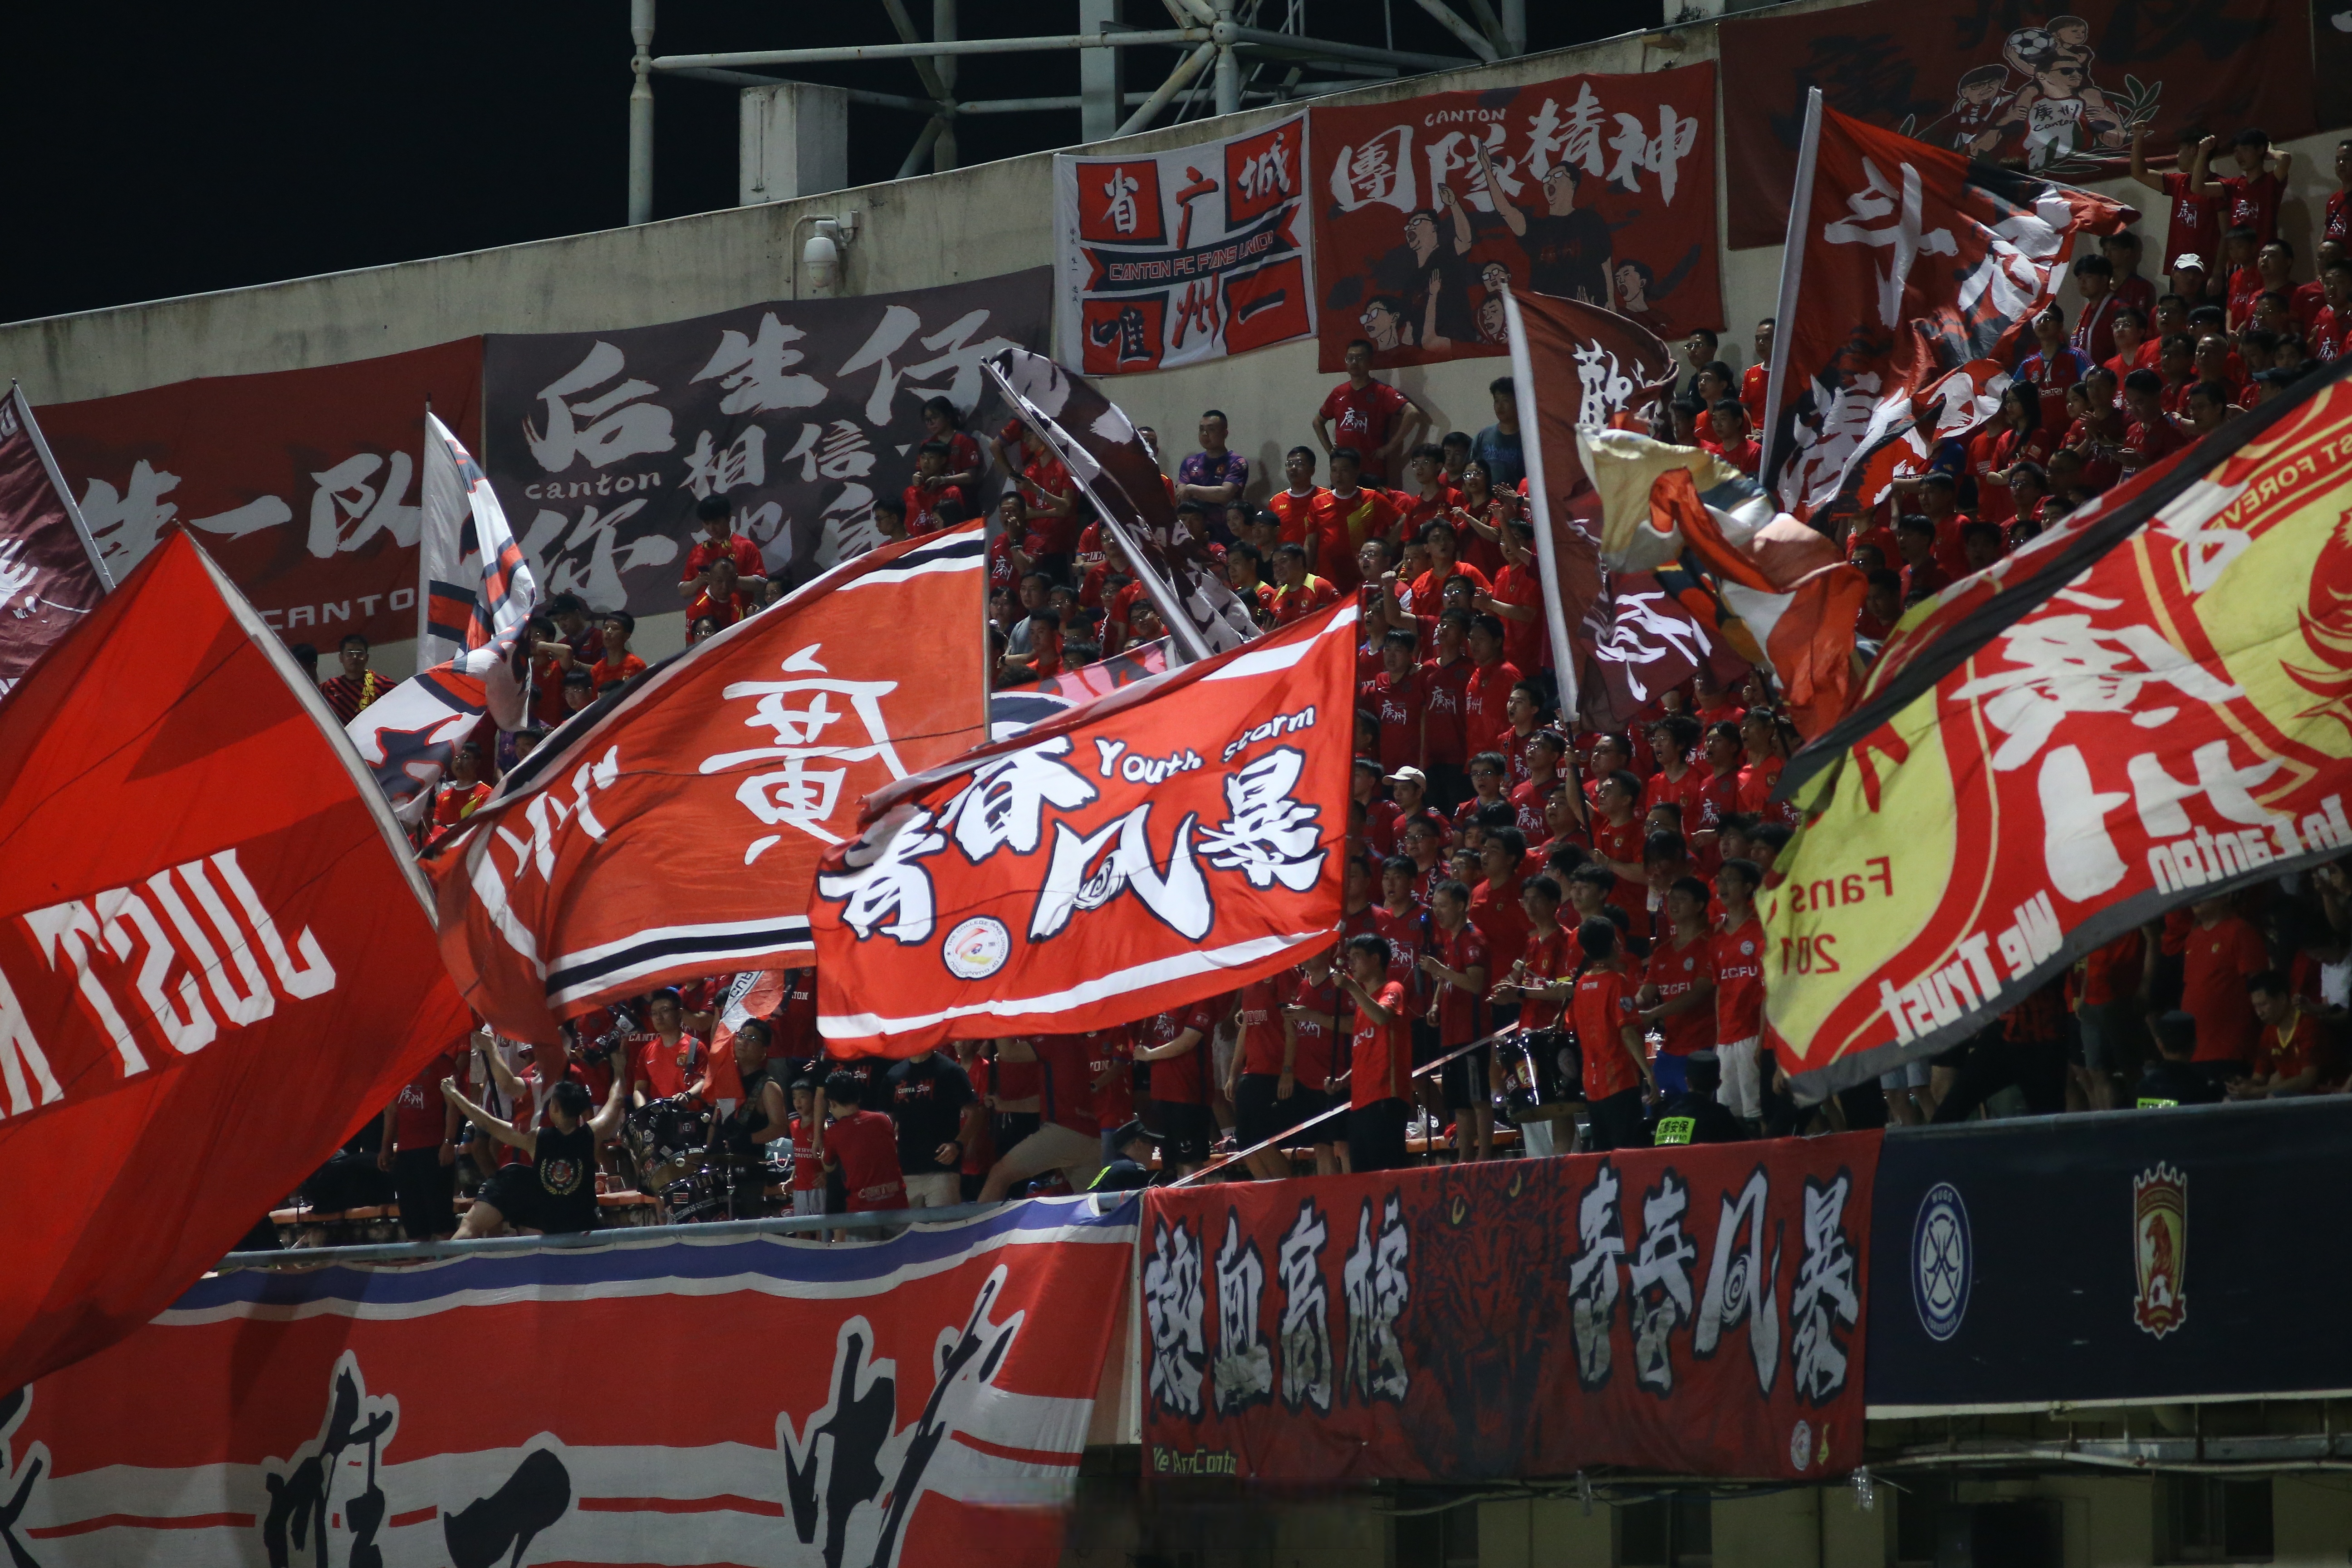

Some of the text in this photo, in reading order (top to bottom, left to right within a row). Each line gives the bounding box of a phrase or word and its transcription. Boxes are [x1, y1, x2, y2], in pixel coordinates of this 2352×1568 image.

[1425, 108, 1506, 127] CANTON
[1109, 260, 1171, 280] CANTON
[1174, 256, 1195, 276] FC
[1197, 245, 1237, 271] FANS
[679, 419, 876, 501] 相信
[524, 470, 662, 501] canton
[1095, 706, 1315, 784] Youth storm
